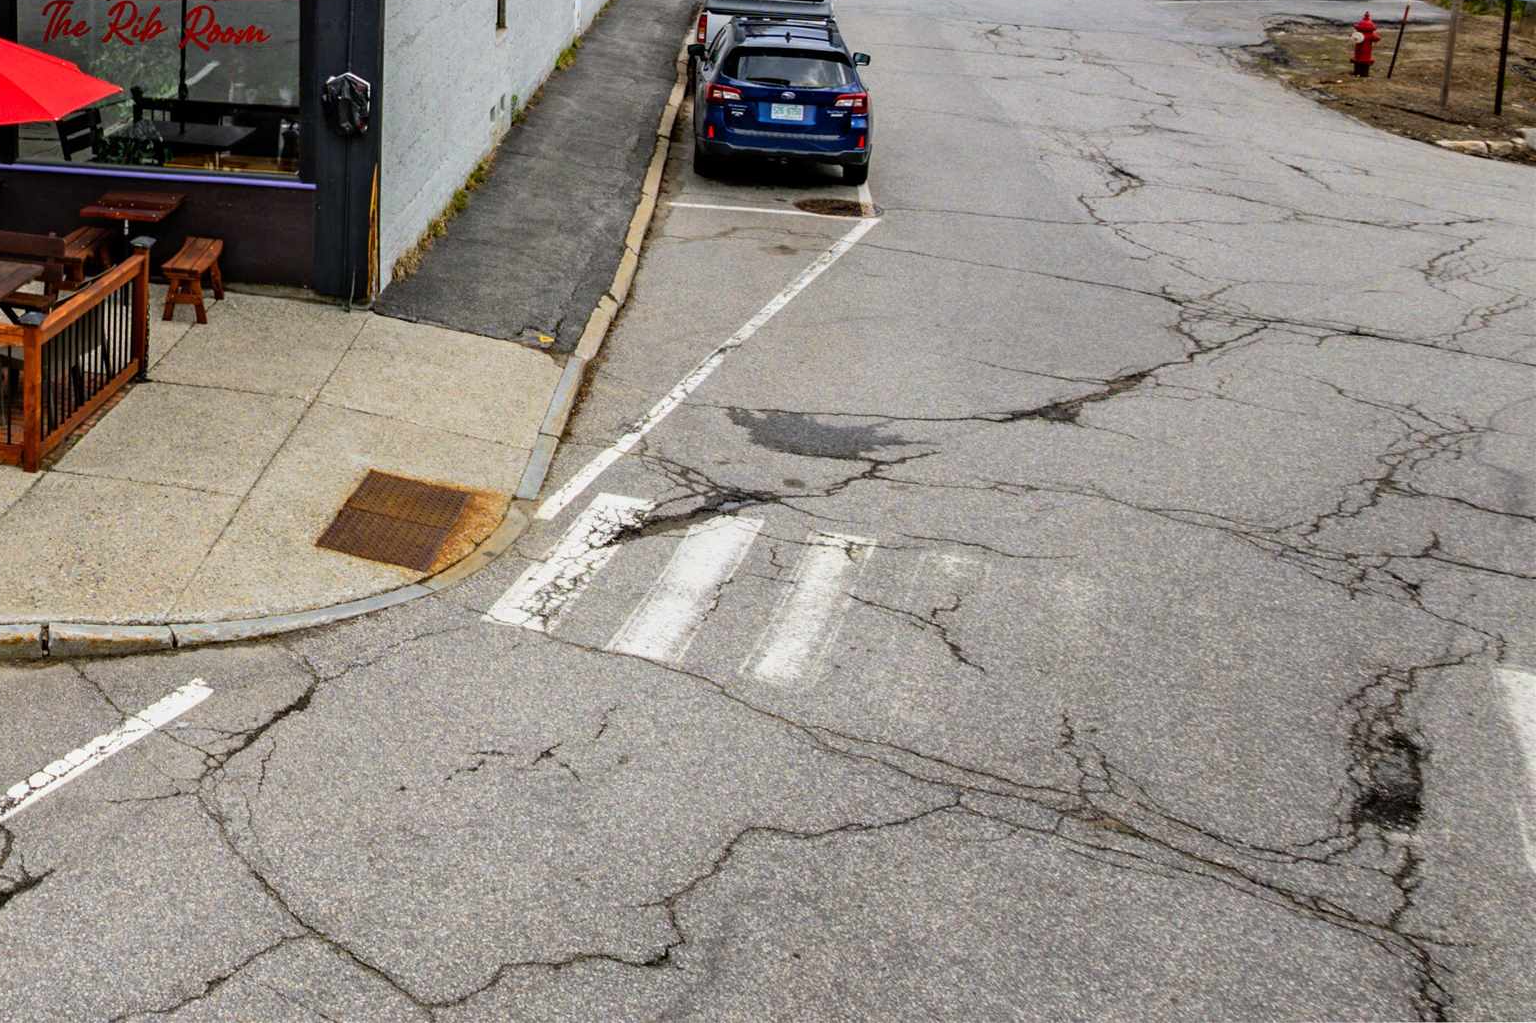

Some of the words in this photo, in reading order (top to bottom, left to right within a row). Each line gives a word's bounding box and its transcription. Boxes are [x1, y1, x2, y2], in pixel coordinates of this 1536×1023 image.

[41, 0, 91, 44] The
[102, 0, 167, 46] Rib
[178, 4, 271, 52] Room
